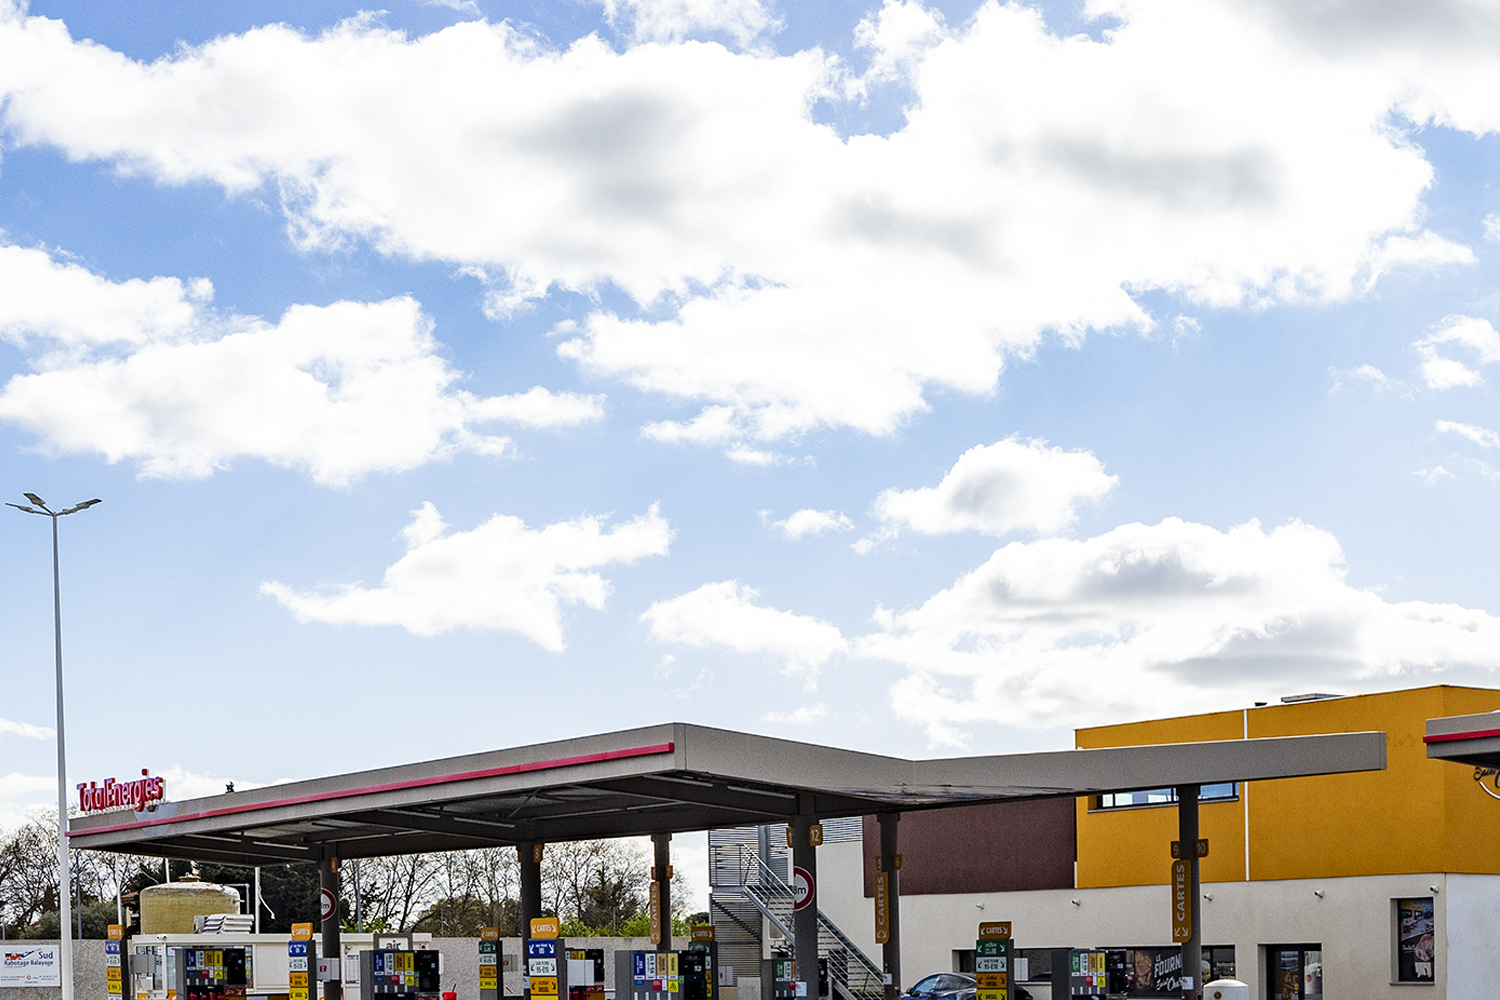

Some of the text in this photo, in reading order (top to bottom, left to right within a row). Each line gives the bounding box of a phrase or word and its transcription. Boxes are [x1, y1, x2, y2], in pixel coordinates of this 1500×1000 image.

[76, 768, 164, 812] TotalEnergies
[810, 829, 820, 841] 12
[1173, 844, 1179, 856] 9
[1196, 842, 1206, 854] 10
[1176, 864, 1185, 922] CARTES
[877, 876, 885, 925] CARTES
[537, 924, 552, 932] CARTES
[986, 926, 1003, 935] CARTES
[386, 940, 401, 949] air
[38, 950, 53, 959] Sud
